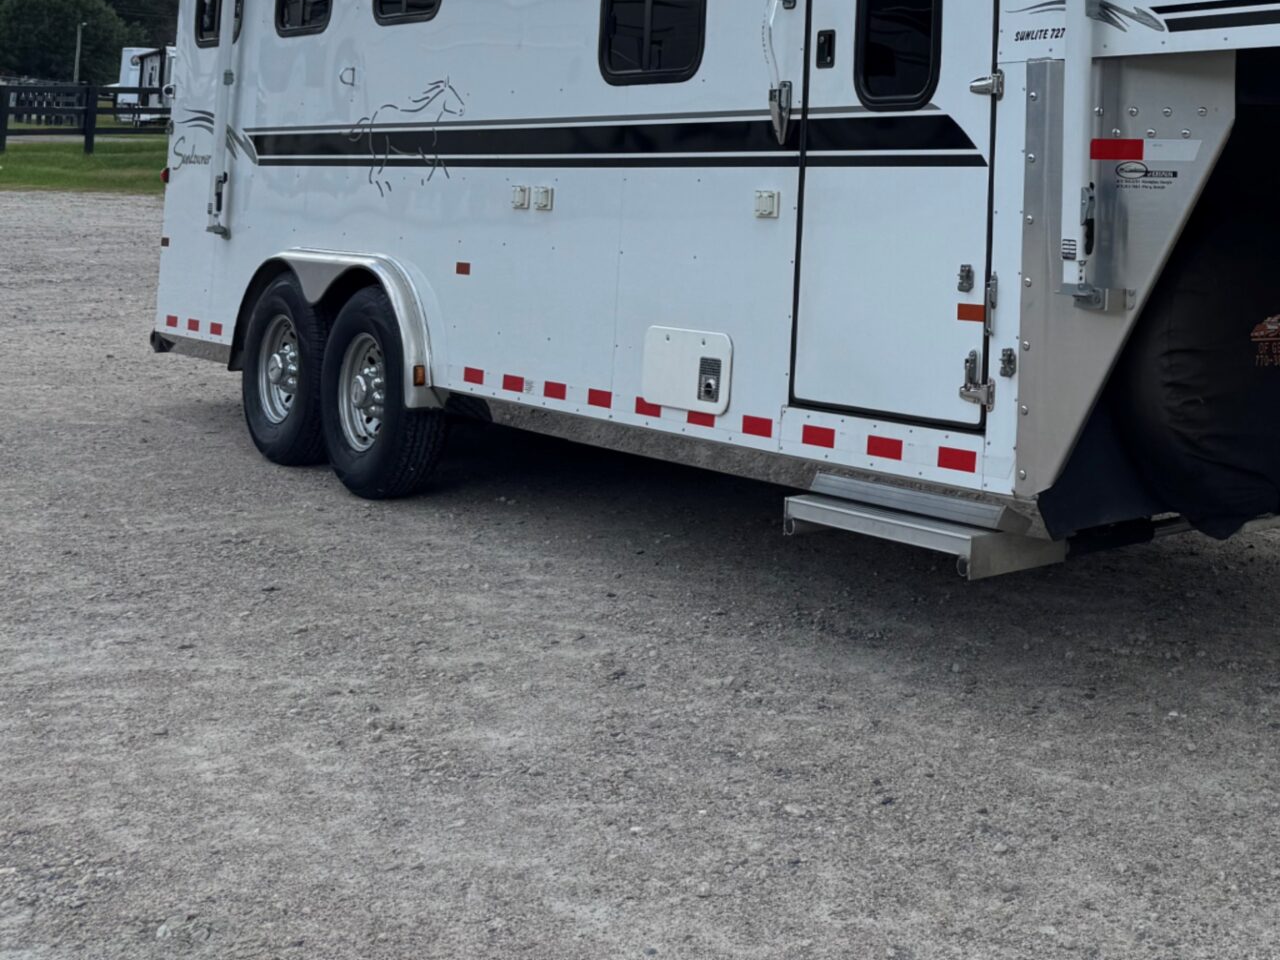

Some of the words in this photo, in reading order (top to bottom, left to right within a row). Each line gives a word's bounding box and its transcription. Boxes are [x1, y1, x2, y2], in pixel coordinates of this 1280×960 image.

[1014, 29, 1049, 41] SUNLITE
[1050, 28, 1066, 39] 727
[1258, 342, 1269, 354] OF
